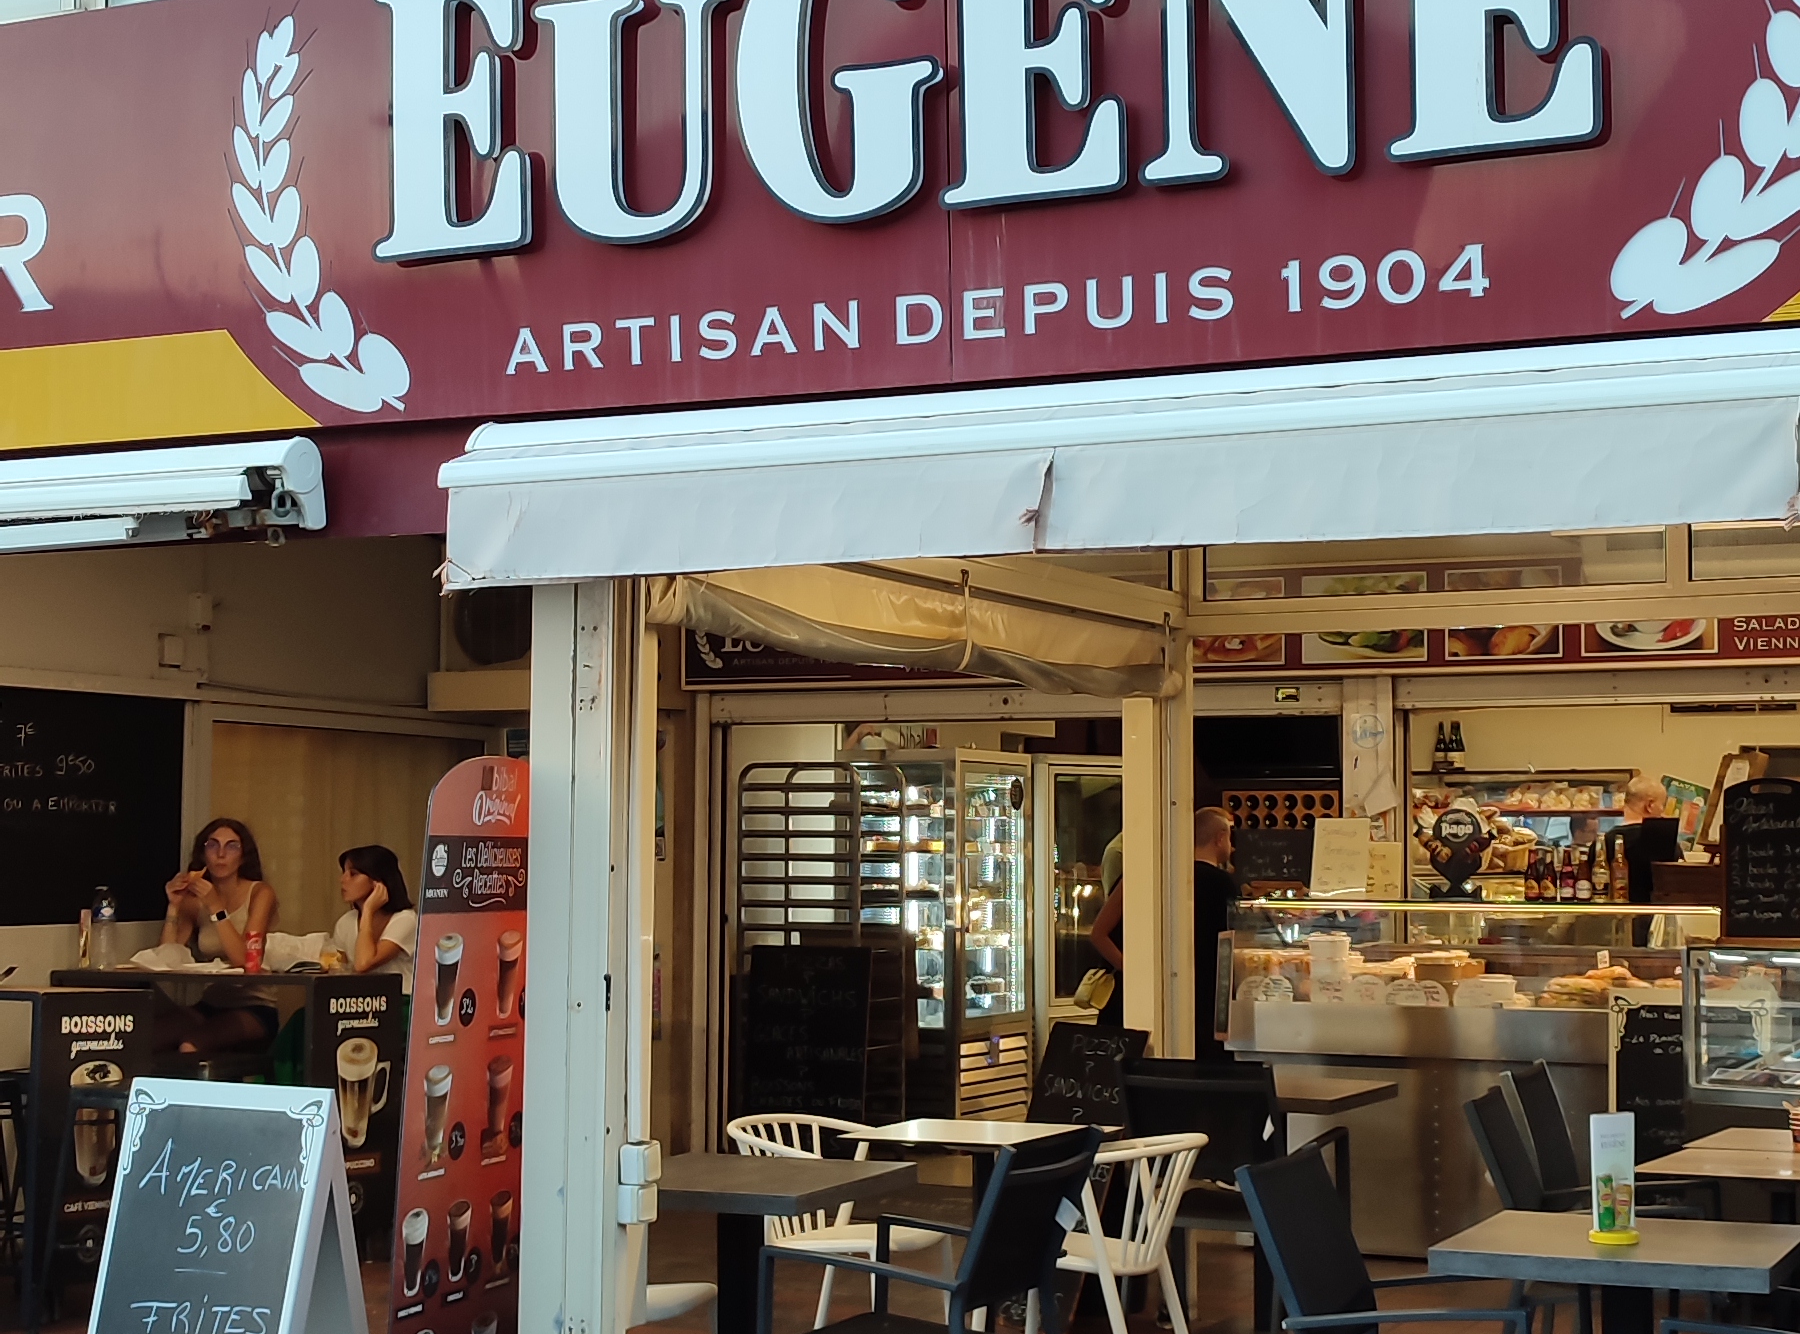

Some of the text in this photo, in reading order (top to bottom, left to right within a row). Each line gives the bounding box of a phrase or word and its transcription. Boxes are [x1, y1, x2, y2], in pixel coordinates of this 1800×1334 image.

[505, 243, 1491, 375] ARTISAN DEPUIS 1904
[1733, 617, 1800, 631] SALAD
[1733, 635, 1800, 652] VIENN
[1440, 823, 1474, 838] pago
[462, 842, 476, 868] Les
[472, 868, 507, 895] Recettes
[329, 995, 387, 1014] BOISSONS
[61, 1014, 134, 1034] BOISSONS
[138, 1137, 300, 1208] AMERICAIN
[176, 1215, 256, 1258] 5,80
